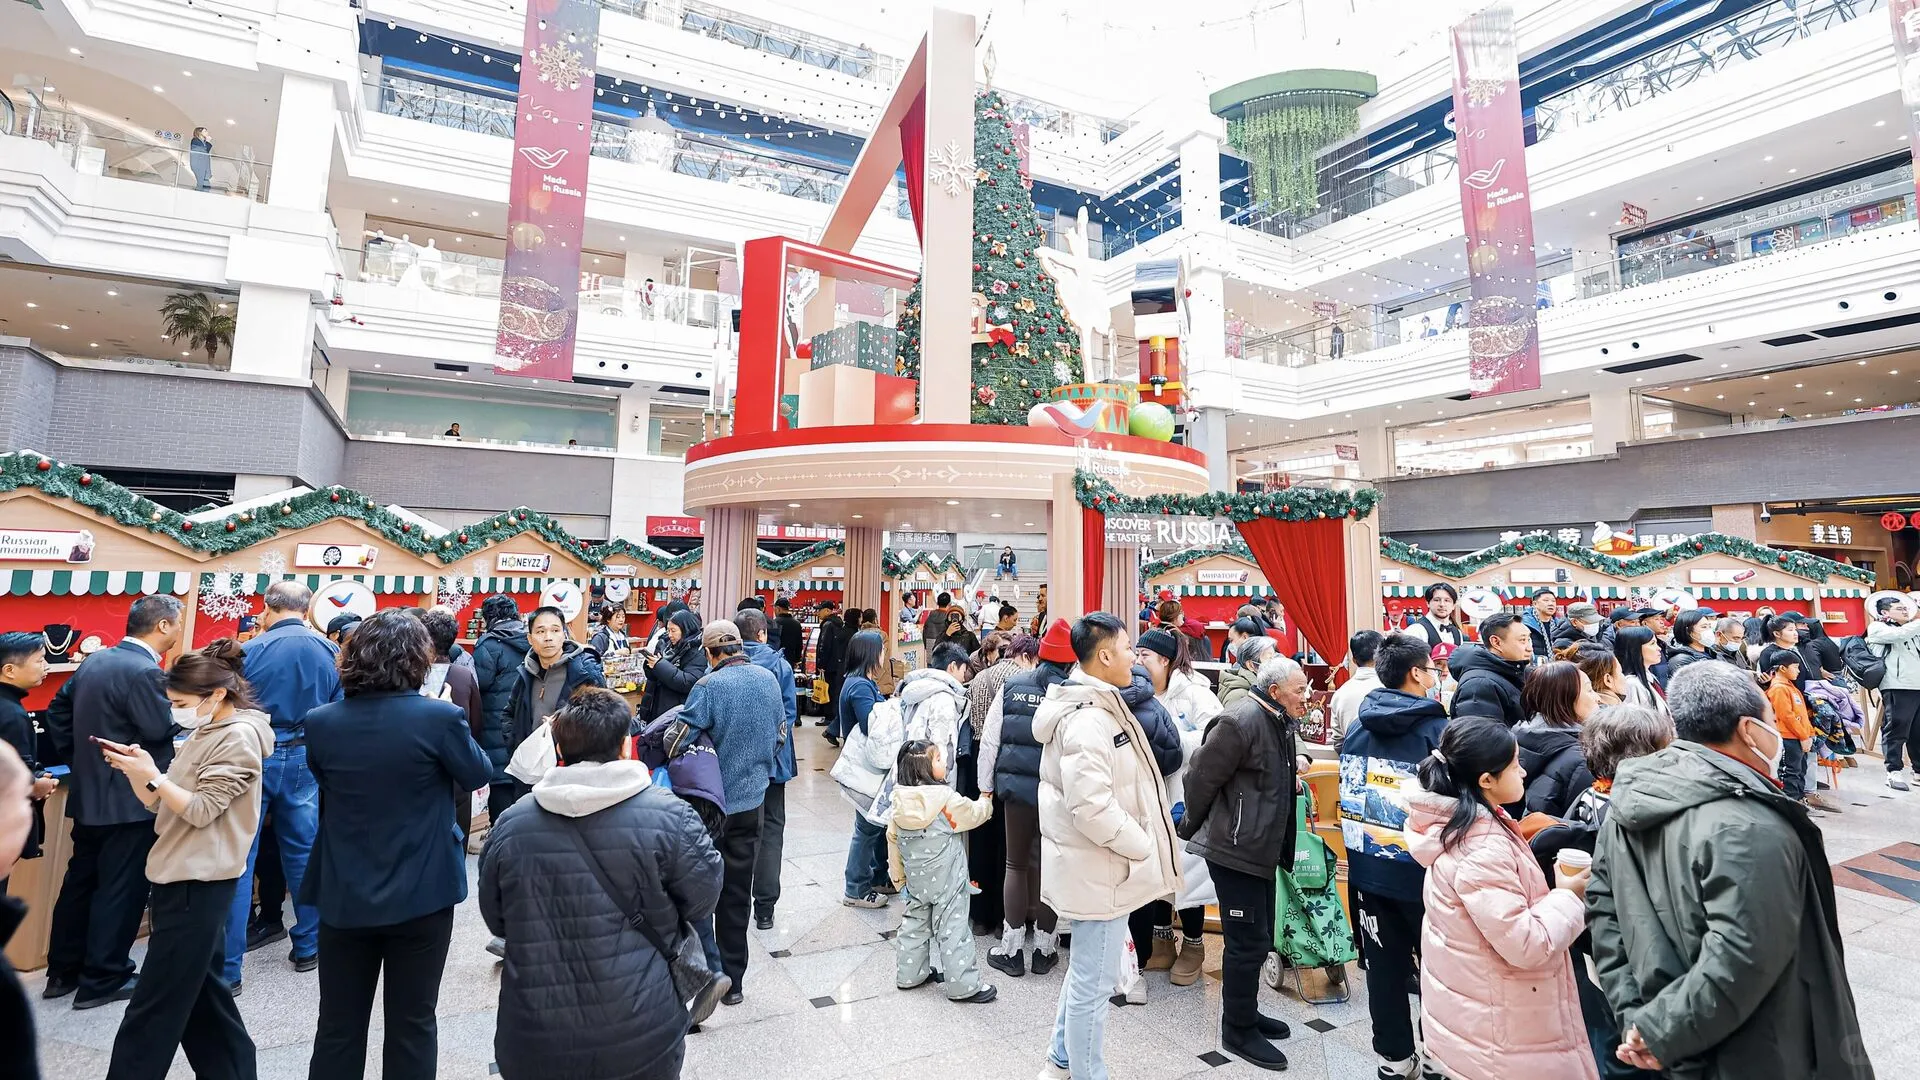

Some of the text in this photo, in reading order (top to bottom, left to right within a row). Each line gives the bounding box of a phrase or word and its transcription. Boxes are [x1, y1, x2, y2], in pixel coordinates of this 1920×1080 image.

[543, 173, 567, 186] Made
[553, 185, 582, 198] Russia
[1487, 188, 1508, 200] Made
[1497, 192, 1524, 205] Russia
[1092, 461, 1129, 476] Russia
[895, 532, 950, 544] 游客服务中心
[1116, 533, 1140, 543] TASTE
[1156, 520, 1233, 545] RUSSIA
[1813, 524, 1852, 544] 麦当劳
[1, 535, 47, 545] Russian
[0, 545, 60, 555] mammoth
[1372, 774, 1394, 785] XTEP
